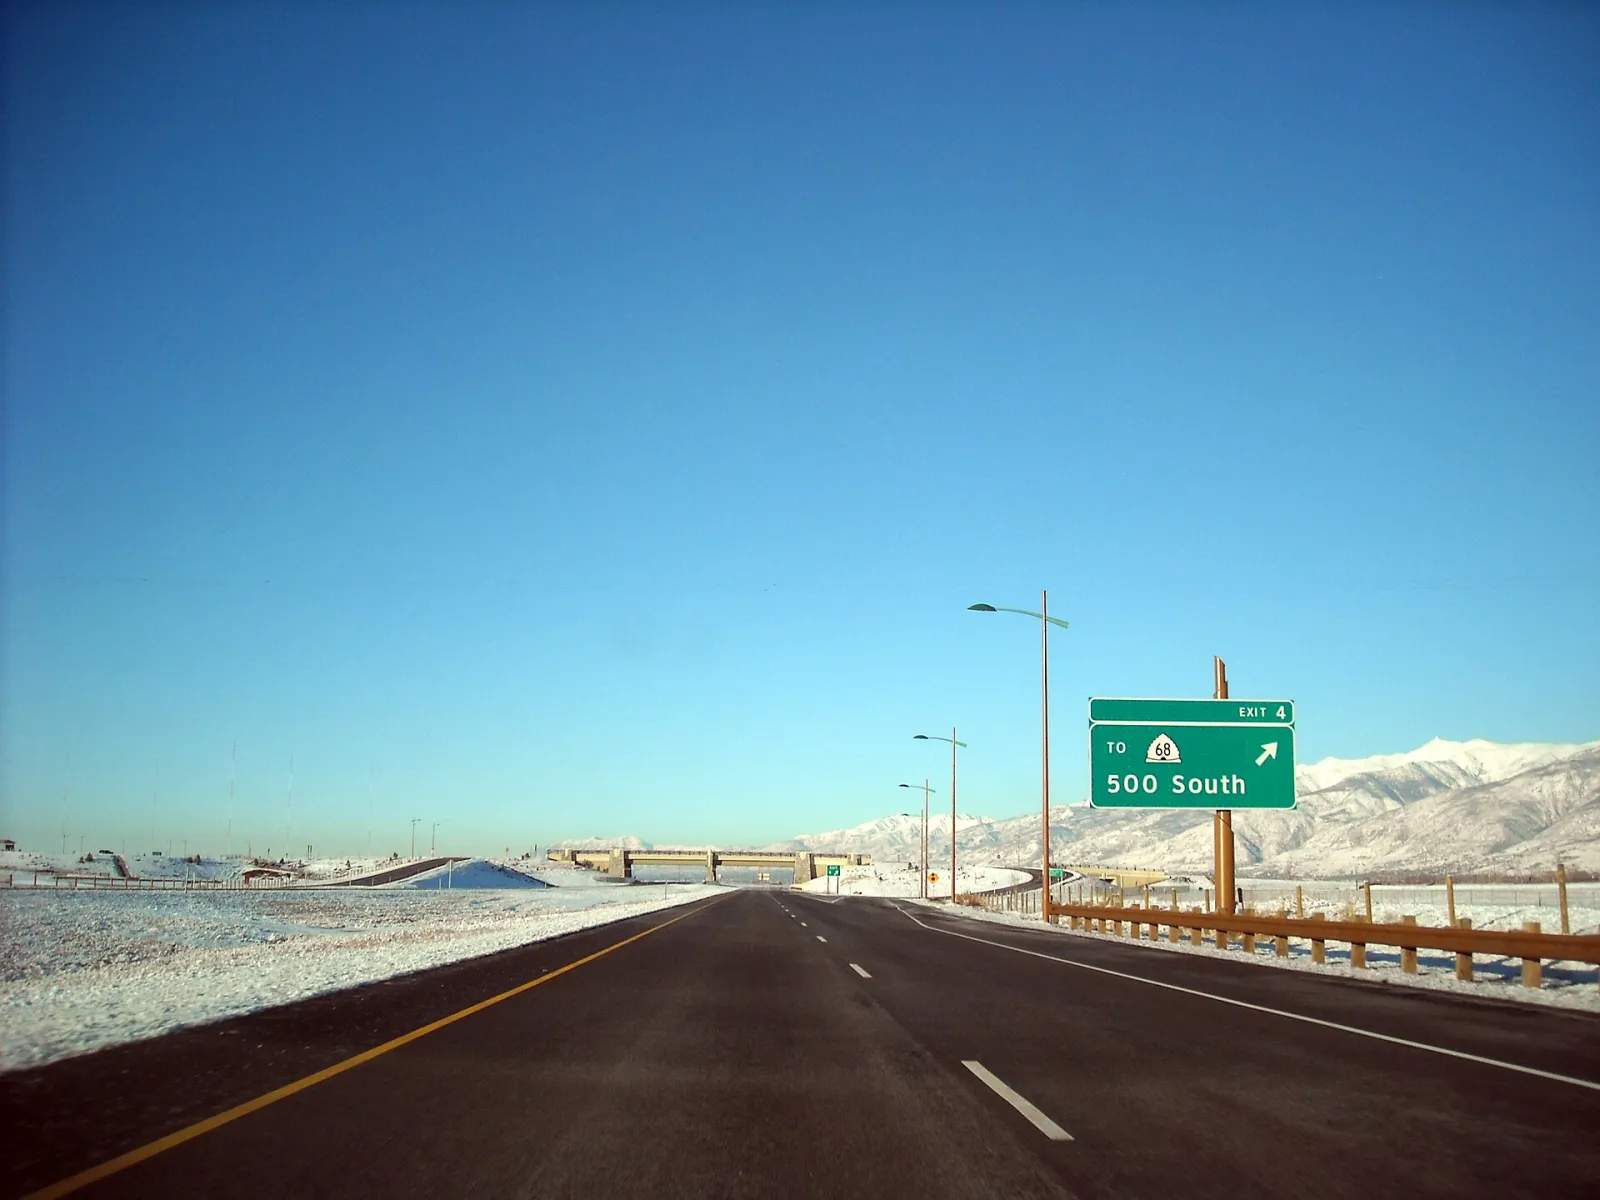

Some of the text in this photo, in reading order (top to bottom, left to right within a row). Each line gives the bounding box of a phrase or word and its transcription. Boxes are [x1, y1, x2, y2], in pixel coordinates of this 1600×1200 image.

[1239, 705, 1286, 720] EXIT 4
[1107, 741, 1126, 754] TO
[1155, 742, 1171, 756] 68
[1107, 774, 1246, 795] 500 South
